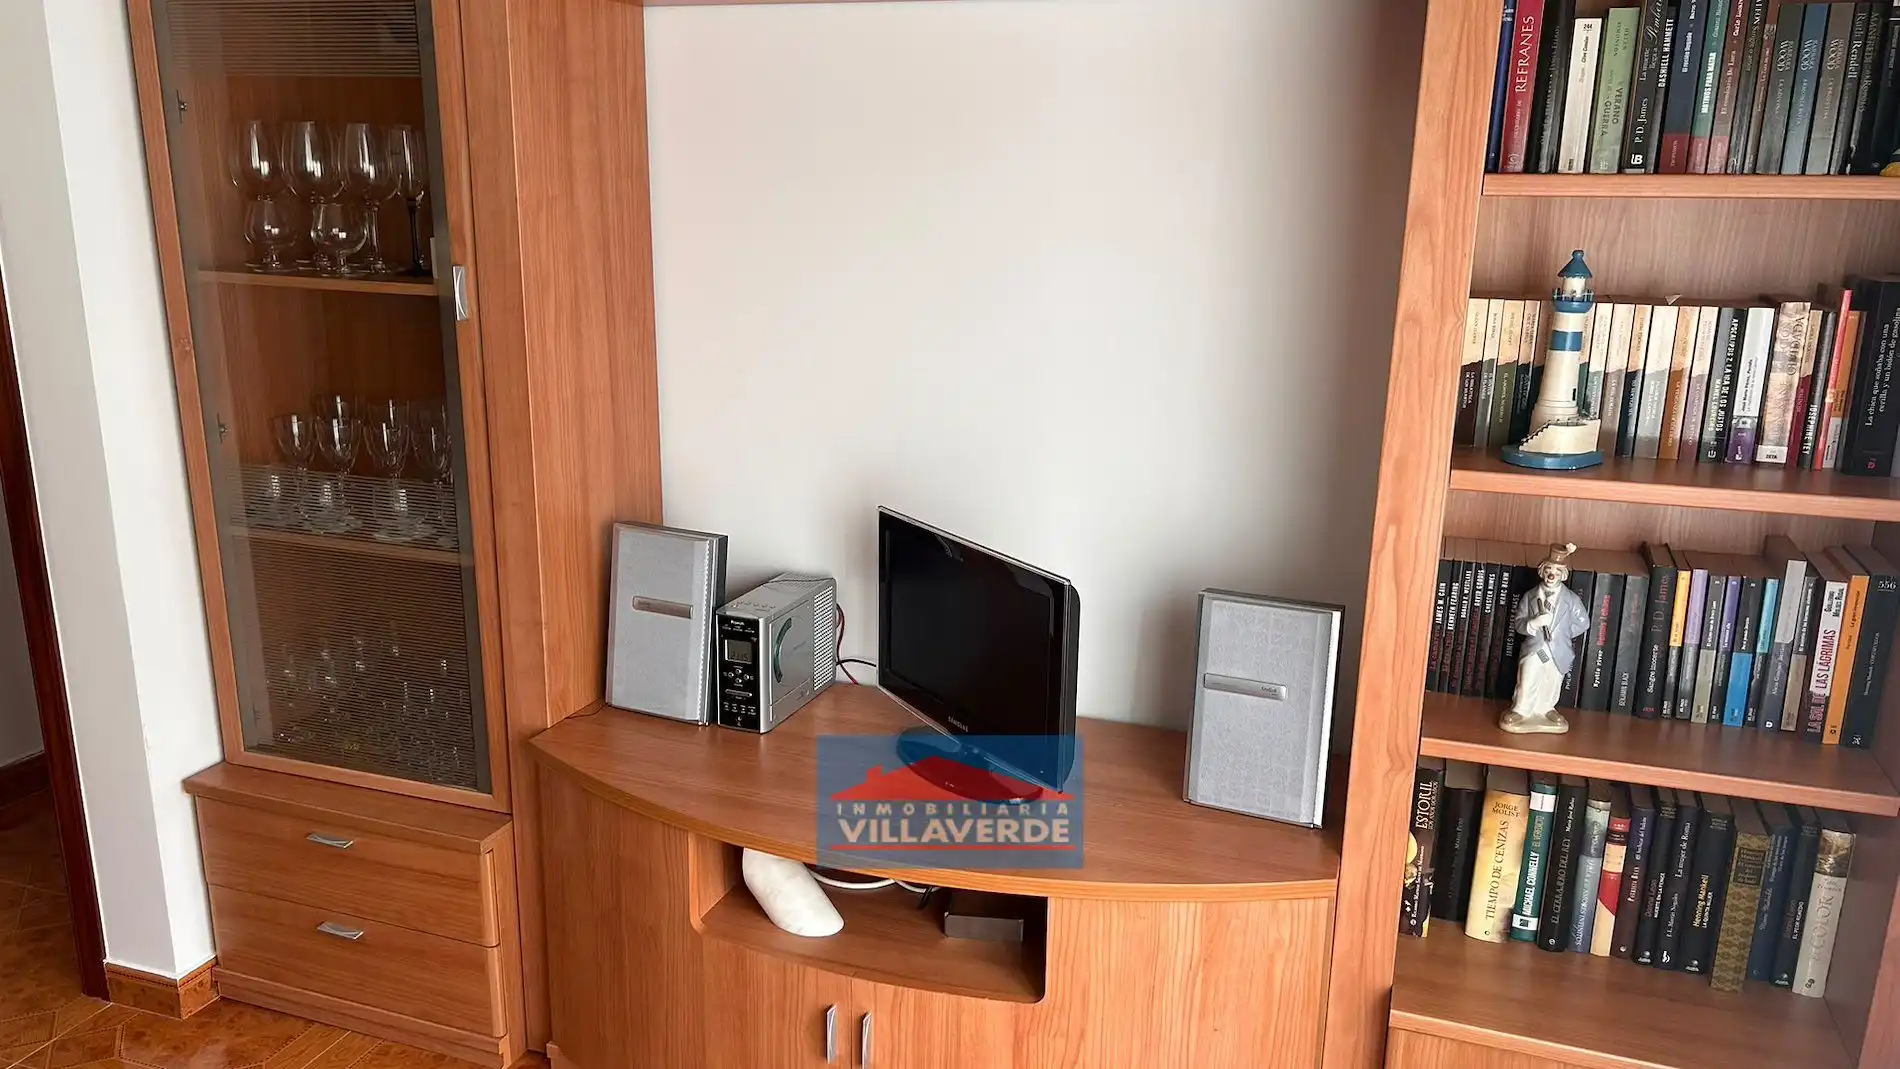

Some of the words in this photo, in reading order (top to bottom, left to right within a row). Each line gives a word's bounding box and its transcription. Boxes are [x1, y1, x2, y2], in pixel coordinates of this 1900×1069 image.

[1662, 18, 1674, 52] HAMMETT
[1853, 12, 1867, 38] Ruth
[1728, 50, 1736, 66] Luca
[1732, 19, 1741, 36] Carlo
[1513, 15, 1536, 94] REFRANES
[1642, 47, 1650, 71] muerte
[1648, 54, 1658, 69] llega
[1707, 51, 1717, 71] MATAR
[1776, 40, 1789, 72] WOOD
[1800, 39, 1813, 71] WOOD
[1826, 38, 1839, 71] WOOD
[1847, 40, 1862, 79] Rendell
[1640, 72, 1647, 81] La
[1658, 53, 1669, 88] DASHIELL
[1705, 71, 1714, 87] PARA
[1611, 87, 1623, 125] VERANO
[1638, 97, 1650, 123] James
[1701, 87, 1712, 114] MOTIVOS
[1600, 100, 1612, 137] GUERRA
[1636, 123, 1645, 134] D.
[1726, 318, 1738, 357] APOCALIPSIS
[1786, 316, 1804, 376] OLVIDADA
[1879, 339, 1887, 353] con
[1888, 338, 1896, 349] de
[1724, 364, 1732, 374] LA
[1873, 354, 1884, 380] soñaba
[1884, 349, 1895, 370] bidón
[1884, 371, 1890, 381] un
[1712, 379, 1722, 400] MANEL
[1721, 386, 1729, 394] DE
[1872, 380, 1880, 394] que
[1719, 395, 1728, 408] LOS
[1867, 394, 1877, 415] chica
[1877, 389, 1887, 412] cerilla
[1708, 401, 1718, 432] LOUREIRO
[1715, 409, 1726, 432] JUSTOS
[1805, 404, 1818, 440] JOSEPHINE
[1865, 415, 1873, 427] La
[1802, 442, 1811, 455] TEY
[1463, 570, 1472, 593] WESTLAKE
[1476, 569, 1485, 589] GOODIS
[1488, 573, 1496, 590] HIMES
[1502, 572, 1510, 588] BEHM
[1654, 574, 1672, 604] James
[1878, 580, 1896, 590] 556
[1450, 582, 1459, 605] FEARING
[1474, 590, 1482, 607] DAVID
[1485, 591, 1494, 613] CHESTER
[1499, 589, 1507, 605] MARC
[1435, 606, 1444, 624] JAMES
[1447, 606, 1456, 630] KENNETH
[1460, 600, 1468, 618] DONALD
[1652, 608, 1665, 621] D.
[1651, 623, 1663, 633] P.
[1506, 638, 1515, 656] JAMES
[1595, 649, 1604, 666] river
[1815, 628, 1836, 672] LÁGRIMAS
[1592, 667, 1602, 688] Mystic
[1621, 672, 1630, 685] BLACK
[1646, 670, 1657, 694] Sangre
[1814, 672, 1829, 690] LAS
[1618, 685, 1628, 707] BENJAMIN
[1812, 692, 1826, 703] DE
[1807, 720, 1822, 734] LA
[1414, 780, 1434, 829] ESTORIL
[1492, 807, 1520, 818] MOLIST
[1494, 801, 1518, 812] JORGE
[1533, 815, 1544, 840] VEREDICTO
[1681, 822, 1691, 840] Roma
[1493, 820, 1510, 864] CENIZAS
[1561, 837, 1571, 852] REY
[1680, 840, 1688, 849] de
[1526, 851, 1540, 886] CONNELLY
[1559, 854, 1568, 868] DEL
[1677, 849, 1687, 869] mujer
[1491, 864, 1503, 879] DE
[1674, 869, 1683, 878] La
[1553, 869, 1566, 913] CERRAJERO
[1697, 874, 1709, 900] Mankell
[1485, 881, 1500, 920] TIEMPO
[1521, 886, 1535, 916] MICHAEL
[1706, 891, 1714, 907] MUJER
[1551, 914, 1560, 924] EL
[1692, 900, 1705, 927] Henning
[1808, 894, 1834, 950] COLOR
